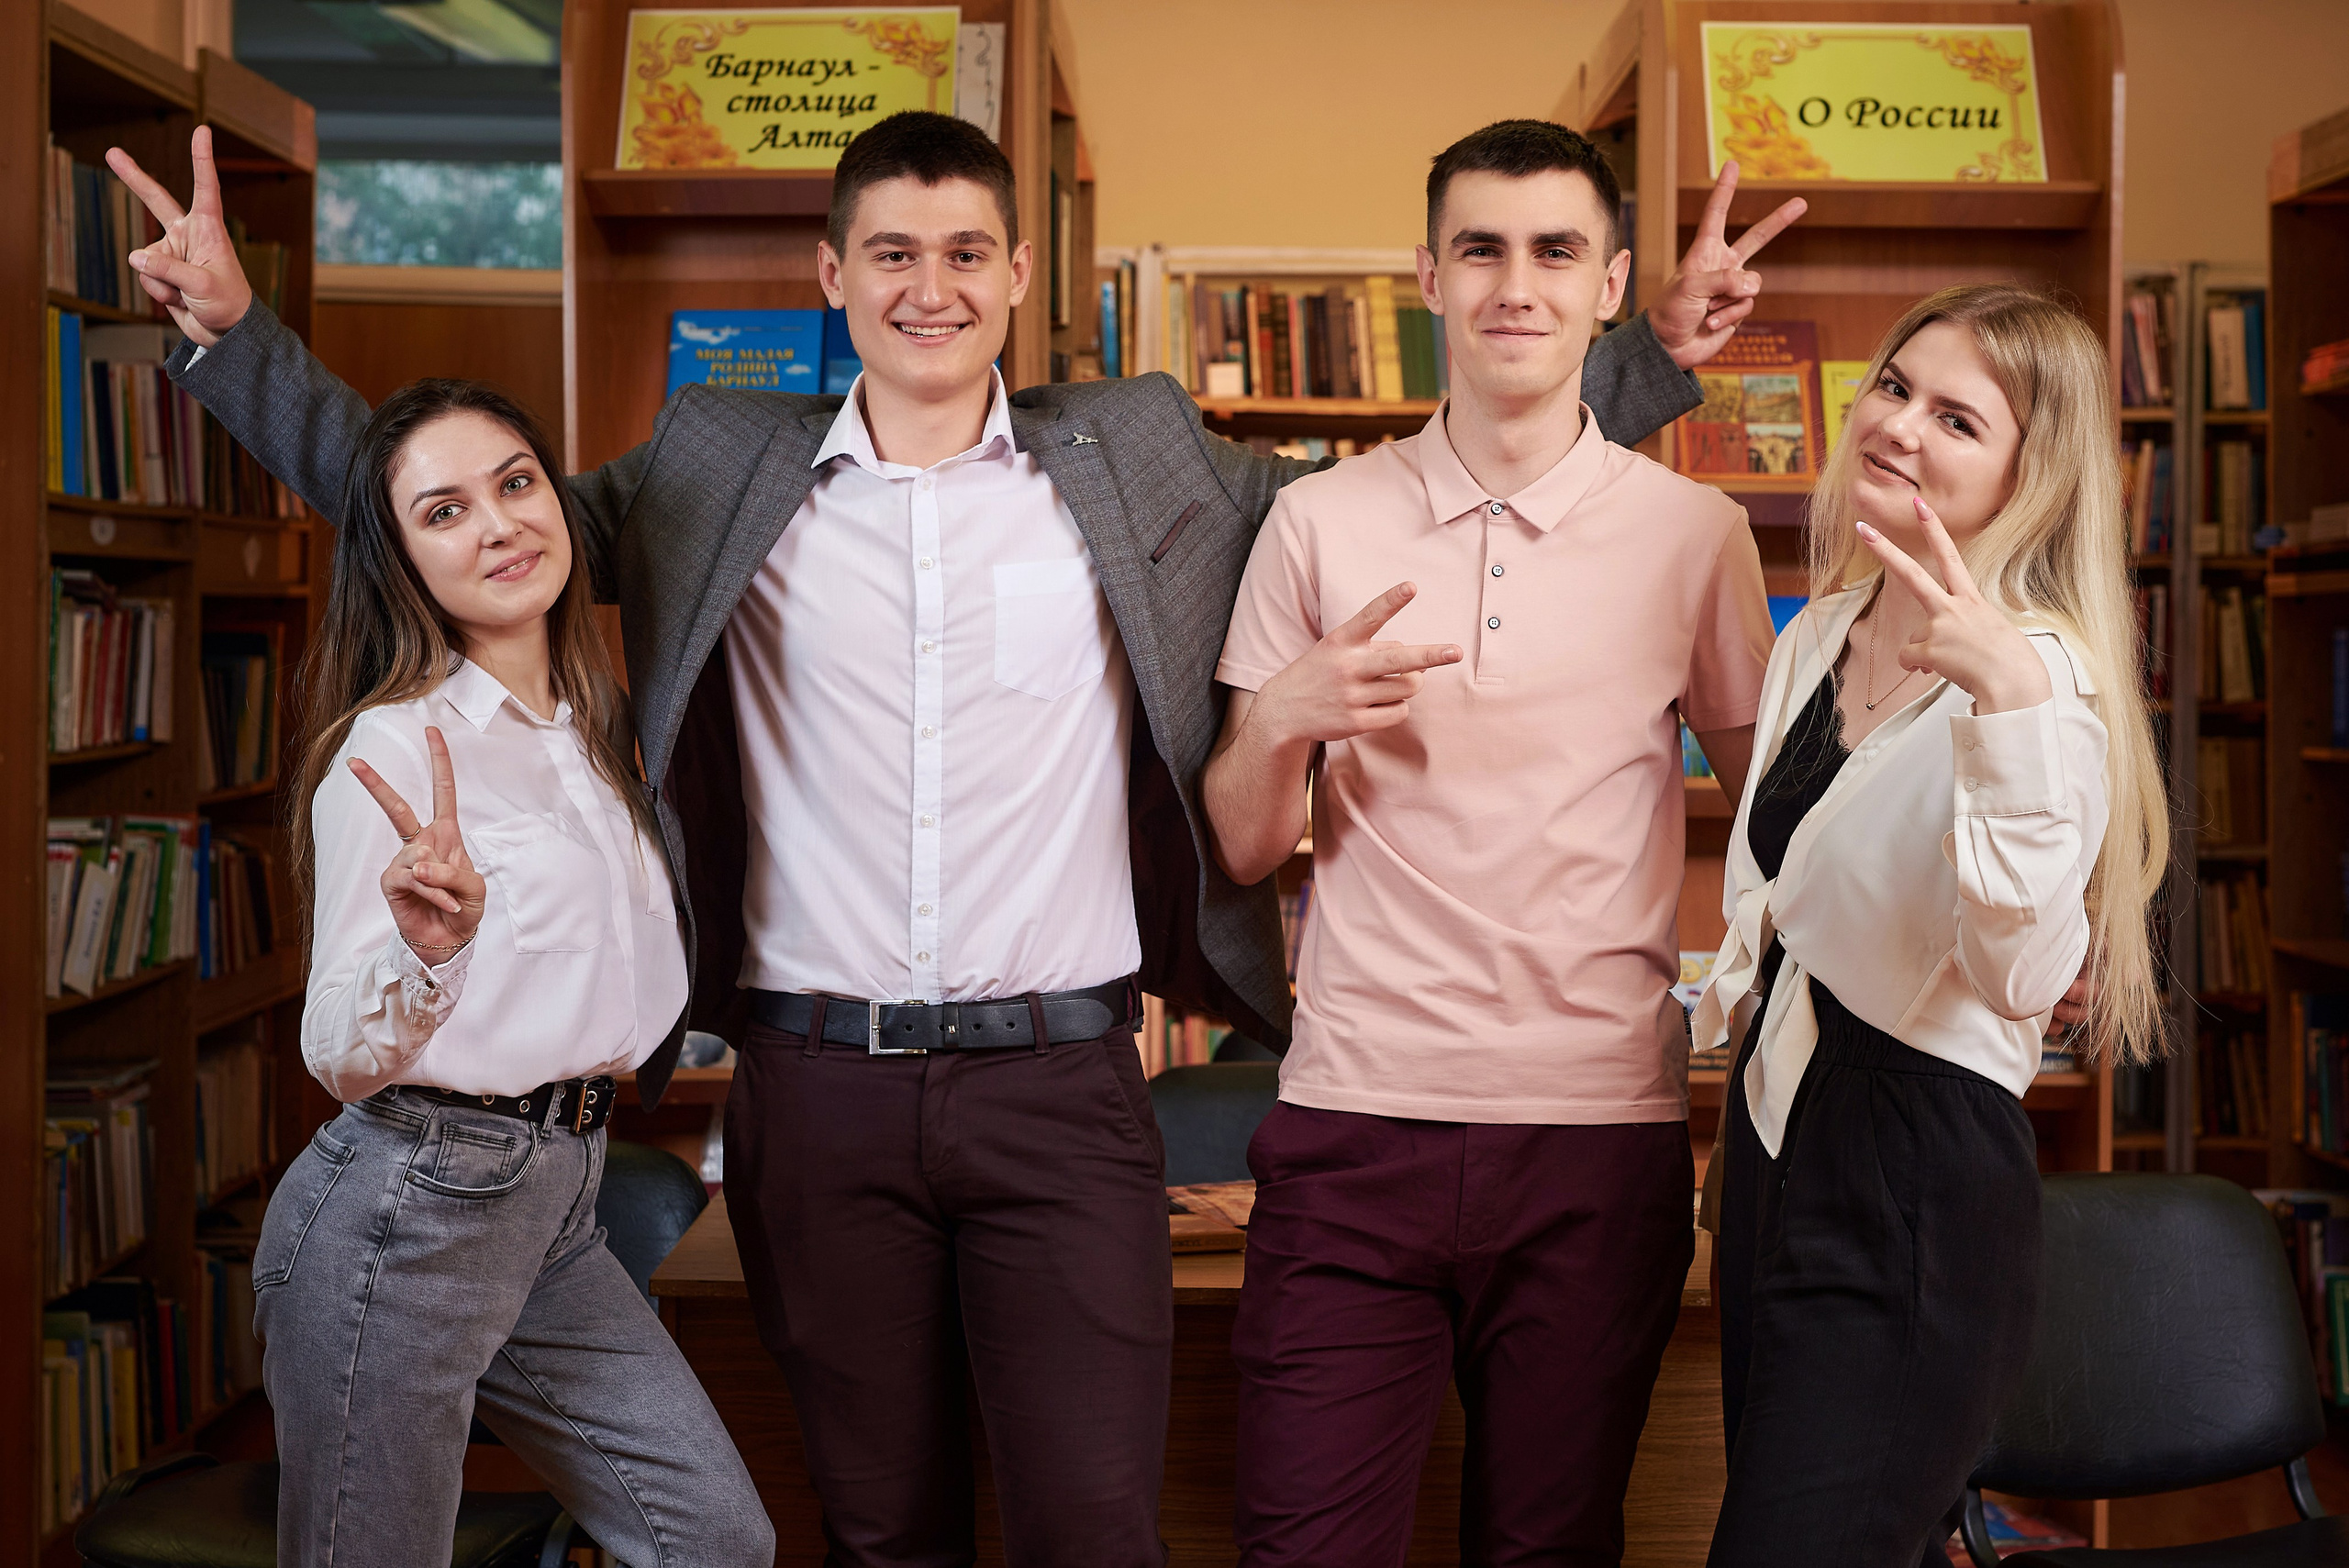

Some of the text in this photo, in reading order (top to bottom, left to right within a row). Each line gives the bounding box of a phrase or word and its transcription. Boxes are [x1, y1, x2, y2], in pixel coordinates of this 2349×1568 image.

[705, 53, 856, 85] Барнаул
[726, 93, 877, 117] столица
[1798, 96, 2002, 129] О России
[748, 124, 853, 153] Алта
